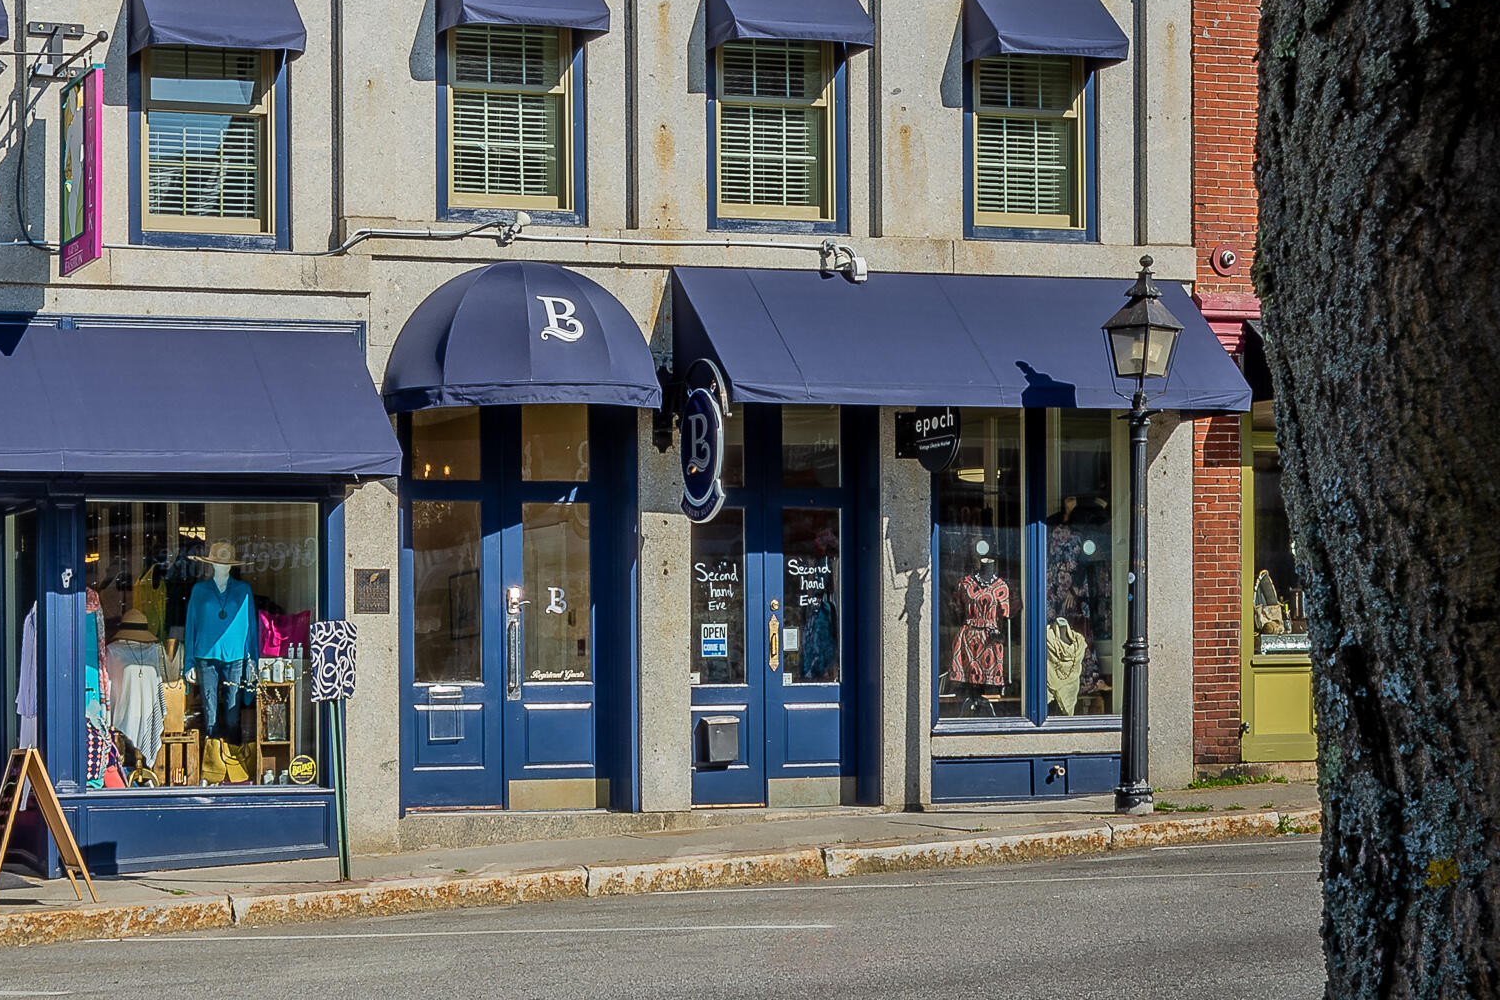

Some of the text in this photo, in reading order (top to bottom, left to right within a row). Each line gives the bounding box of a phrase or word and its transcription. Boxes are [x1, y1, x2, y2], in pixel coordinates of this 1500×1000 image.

[536, 295, 584, 342] B
[915, 406, 954, 437] epoch
[686, 413, 711, 475] B
[694, 562, 739, 583] Second
[787, 558, 832, 575] Second
[709, 582, 735, 599] hand
[800, 575, 825, 591] hand
[545, 586, 567, 614] B
[707, 600, 727, 611] Eve
[799, 594, 820, 607] Eve
[703, 626, 726, 639] OPEN
